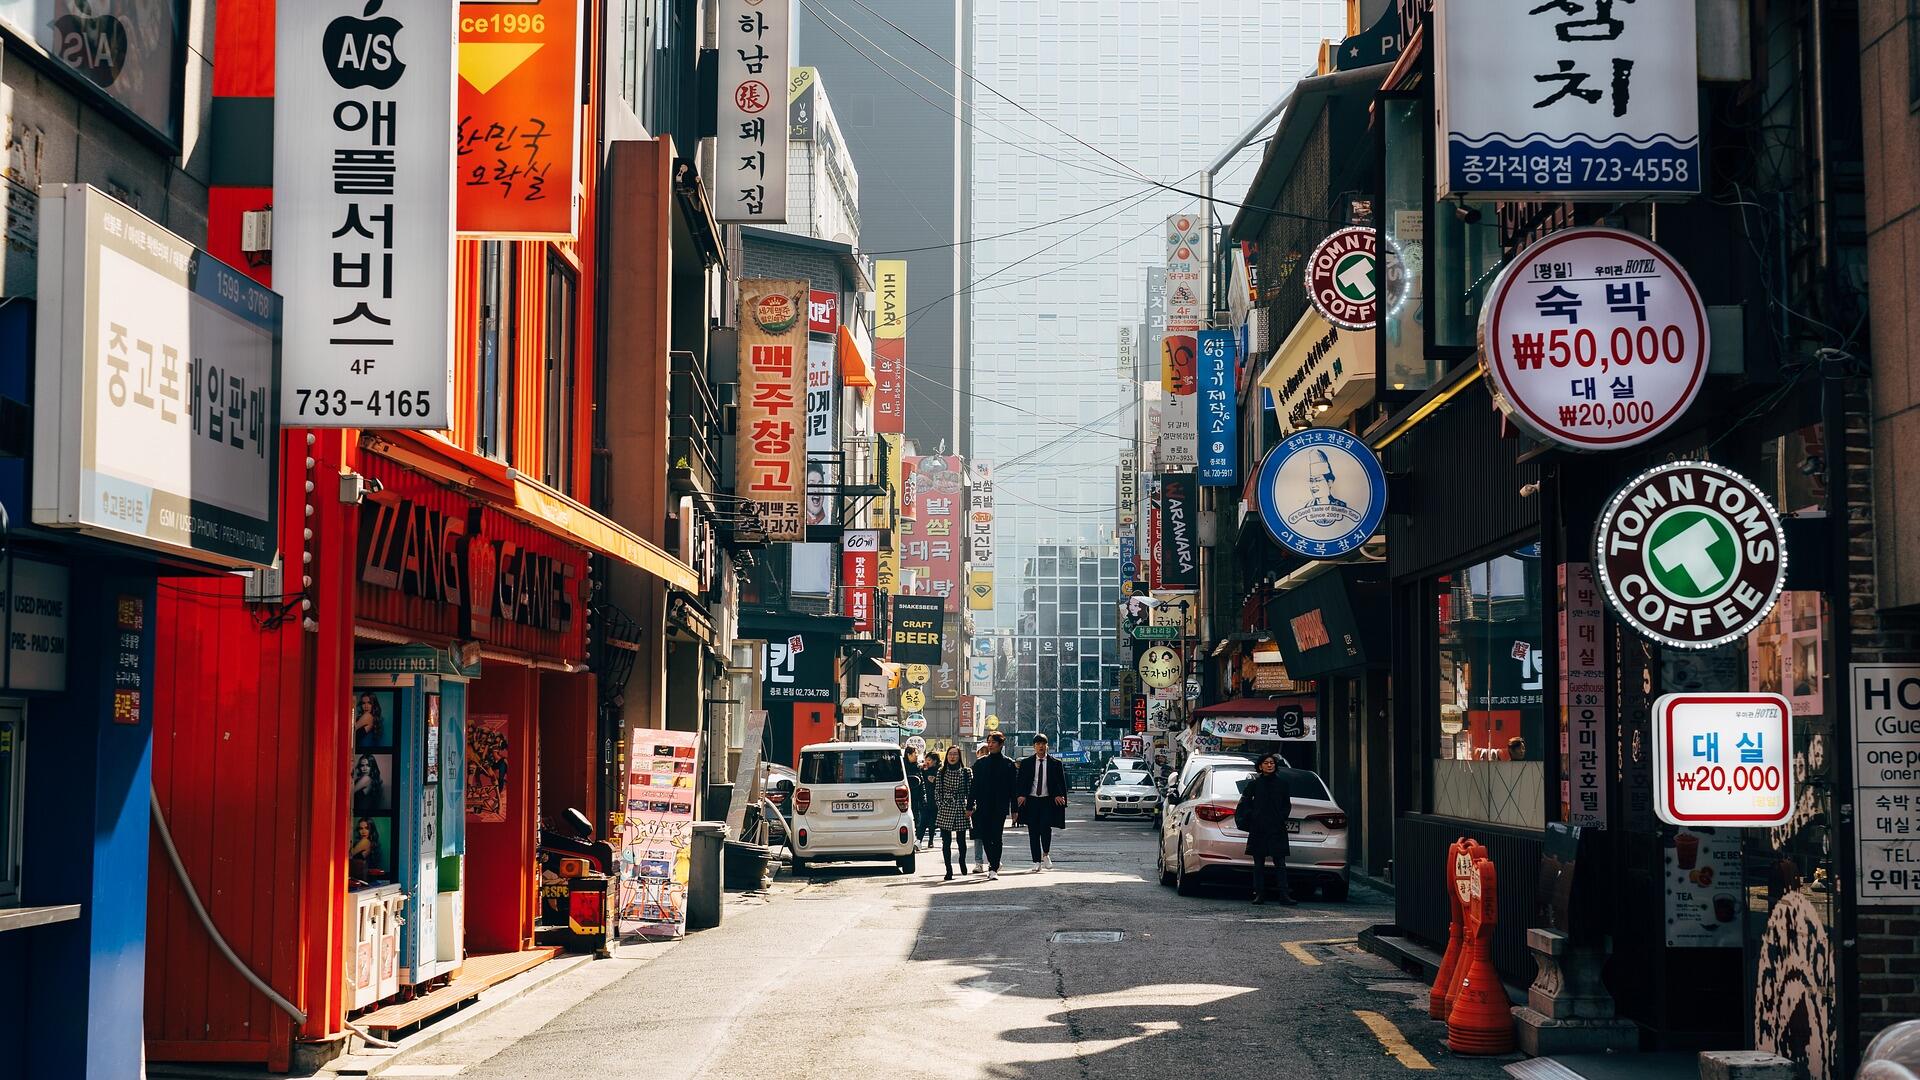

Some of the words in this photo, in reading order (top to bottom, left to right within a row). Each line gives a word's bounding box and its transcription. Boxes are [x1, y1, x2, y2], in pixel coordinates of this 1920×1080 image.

[337, 33, 393, 71] A/S
[1462, 155, 1572, 184] 종각직영점
[1580, 158, 1689, 182] 723-4558
[329, 100, 397, 346] 애플서비스
[1315, 239, 1344, 281] TOM
[1345, 234, 1360, 249] N
[1363, 235, 1376, 250] T
[1594, 264, 1624, 278] 우미관
[1624, 258, 1656, 274] HOTEL
[883, 273, 897, 327] HIKARI
[1320, 288, 1376, 321] COFF
[1176, 307, 1191, 315] 4F
[350, 359, 376, 375] 4F
[296, 389, 431, 417] 733-4165
[751, 345, 795, 492] 맥주창고
[1120, 459, 1133, 512] 일본유학
[1610, 483, 1667, 556] TOM
[1668, 473, 1695, 501] N
[1701, 474, 1775, 565] TOMS
[898, 603, 939, 611] SHAKESBEER
[1619, 573, 1764, 636] COFFEE
[902, 620, 934, 629] CRAFT
[895, 631, 939, 645] BEER
[368, 657, 407, 670] BOOTH
[410, 657, 436, 670] NO.1
[1140, 665, 1181, 680] 국자비어
[782, 687, 795, 697] 본점
[795, 688, 830, 697] 02.734.7788
[1569, 681, 1605, 693] Guesthouse
[1754, 708, 1779, 719] HOTEL
[1578, 709, 1598, 812] 우미관호텔
[1867, 750, 1904, 765] one
[1880, 768, 1912, 782] (one
[851, 801, 870, 810] 8126
[1875, 794, 1911, 811] 숙박
[1876, 816, 1910, 834] 대실
[1676, 892, 1693, 901] TEA
